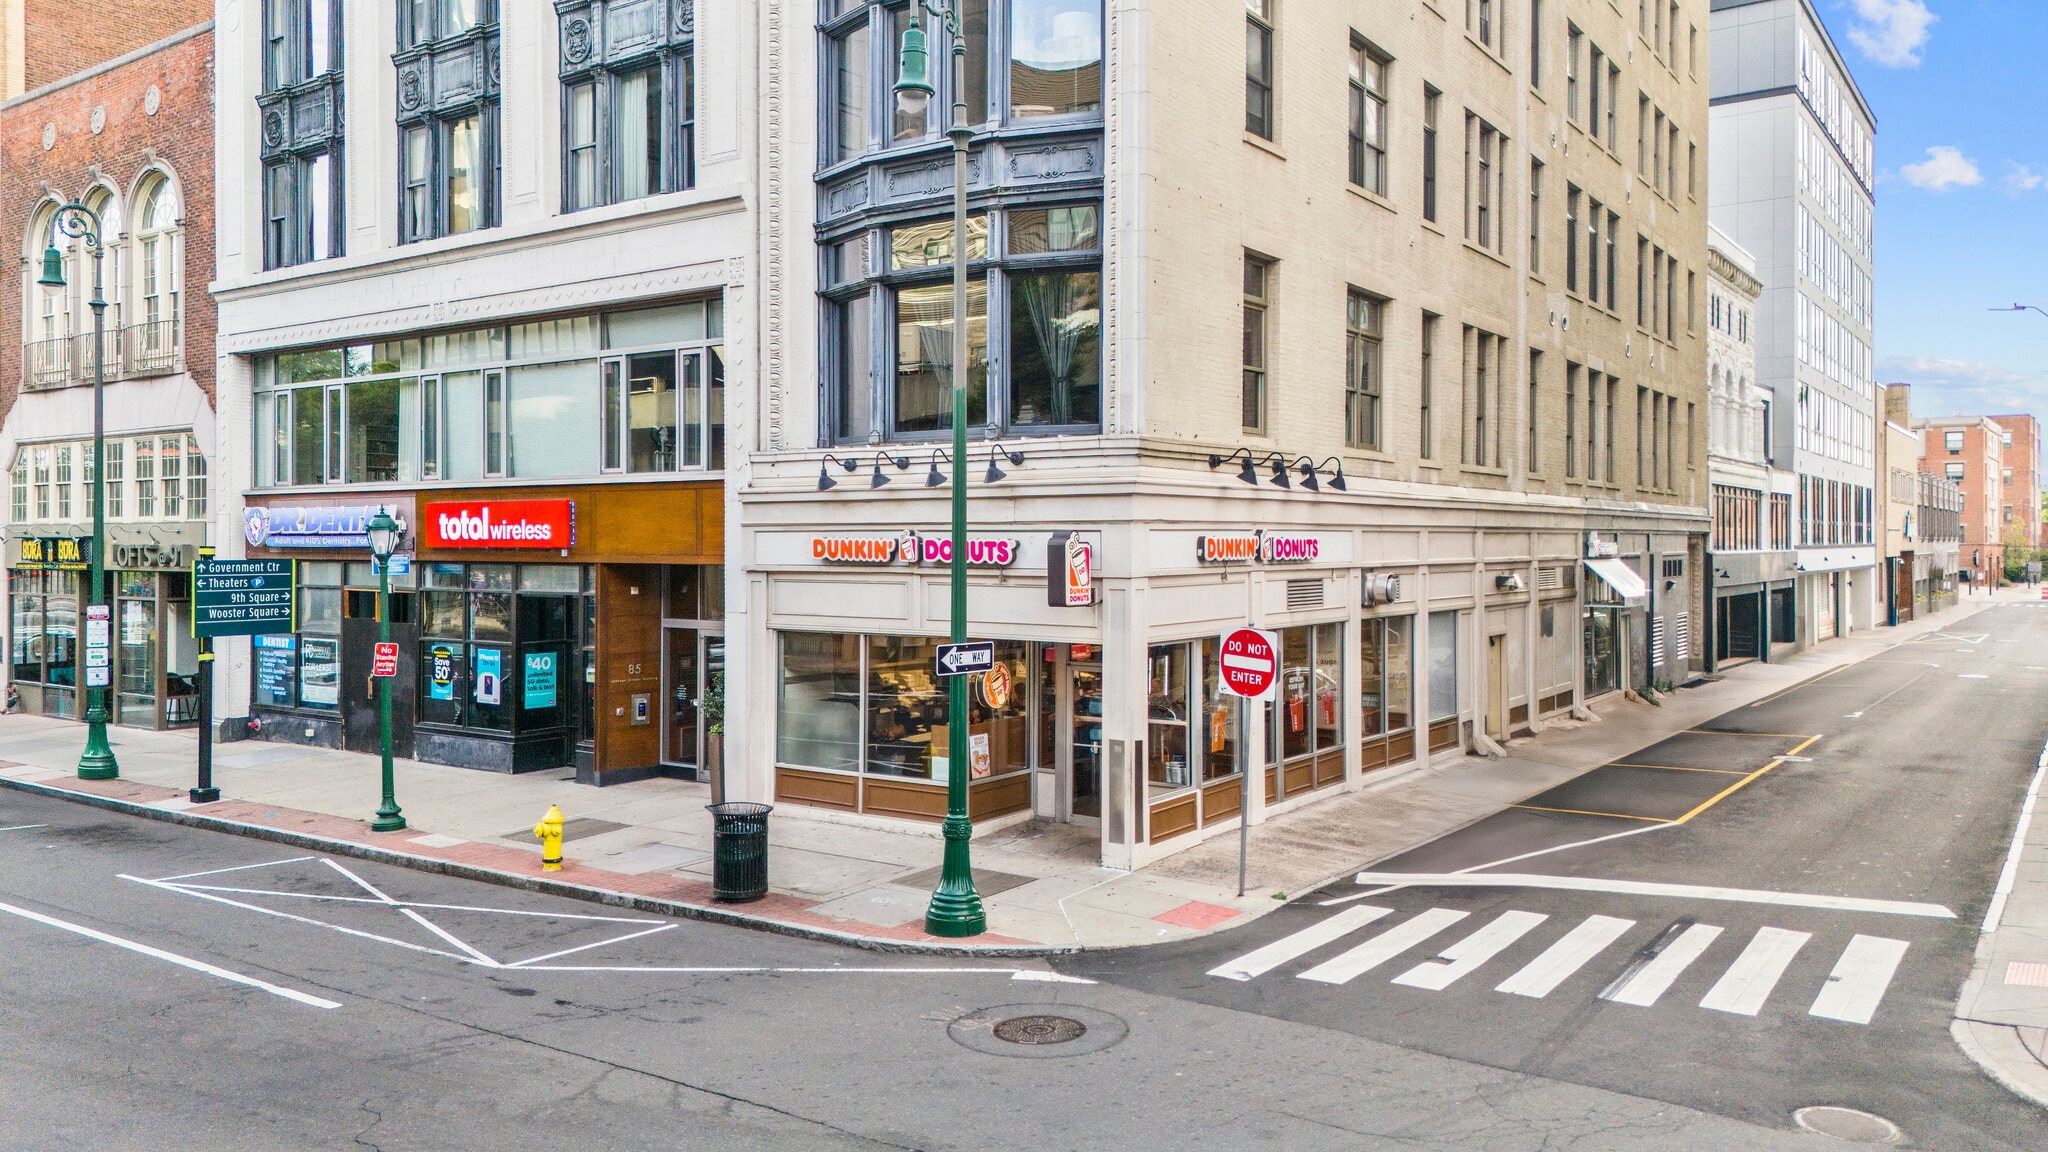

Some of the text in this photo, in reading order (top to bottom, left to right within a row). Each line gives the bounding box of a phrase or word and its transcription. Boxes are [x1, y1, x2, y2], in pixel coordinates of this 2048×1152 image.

[438, 507, 489, 540] total
[490, 519, 551, 540] wireless
[22, 539, 81, 562] BORA BORA
[813, 539, 1009, 563] DUNKIN' DOUTS
[1207, 538, 1318, 558] DUNKIN' DONUTS
[170, 544, 184, 568] 91
[209, 562, 280, 573] Government Ctr
[209, 578, 248, 588] Theaters
[231, 592, 280, 604] 9th Square
[209, 607, 280, 619] Wooster Square
[263, 637, 289, 648] DENTIST
[1228, 641, 1268, 656] DO NOT
[434, 657, 450, 666] Save
[527, 656, 551, 670] $40
[949, 651, 985, 665] ONE WAY
[628, 664, 641, 675] 85
[1231, 670, 1262, 685] ENTER
